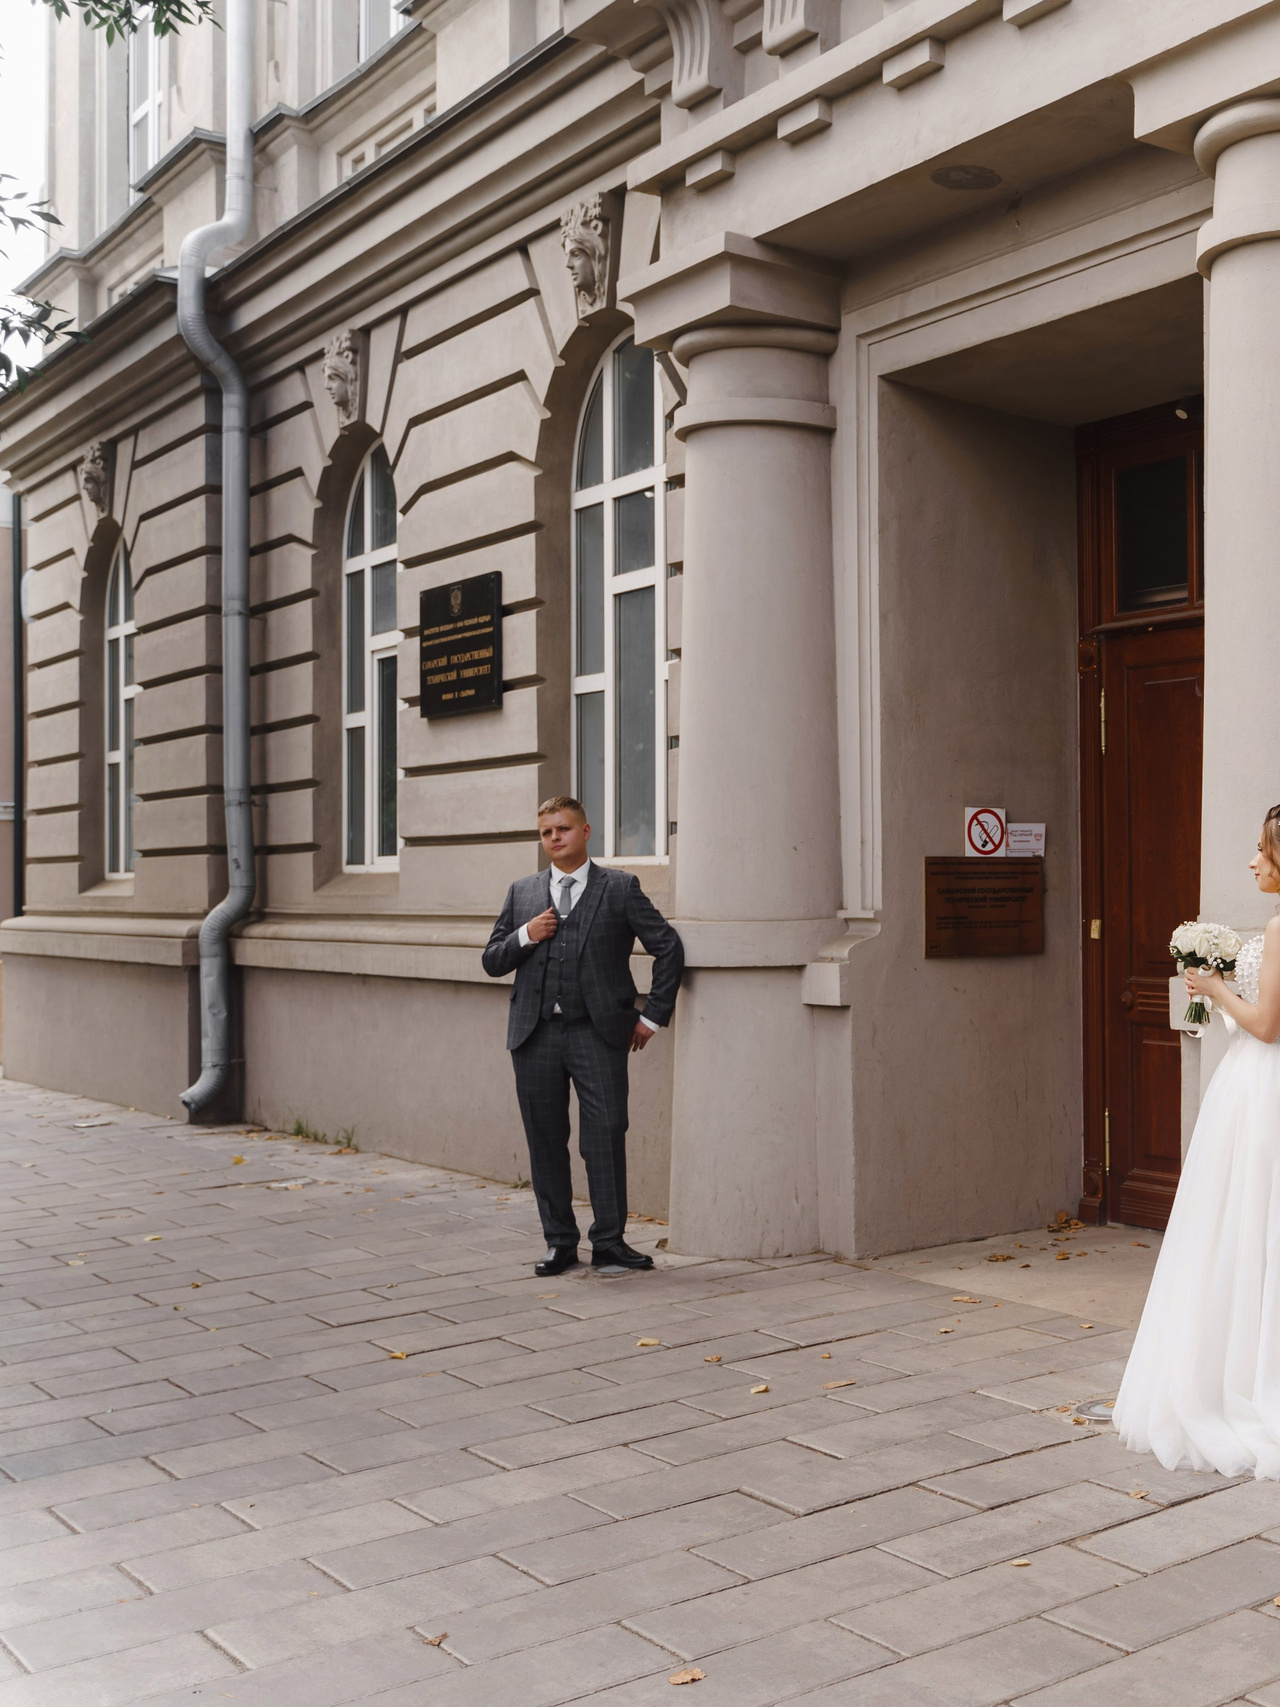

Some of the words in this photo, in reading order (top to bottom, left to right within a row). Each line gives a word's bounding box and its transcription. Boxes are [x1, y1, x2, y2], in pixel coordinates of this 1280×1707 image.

[422, 656, 447, 670] САМАРСКИЙ
[450, 645, 493, 665] ГОСУДАРСТВЕННЫЙ
[460, 664, 491, 679] УНИВЕРСИТЕТ
